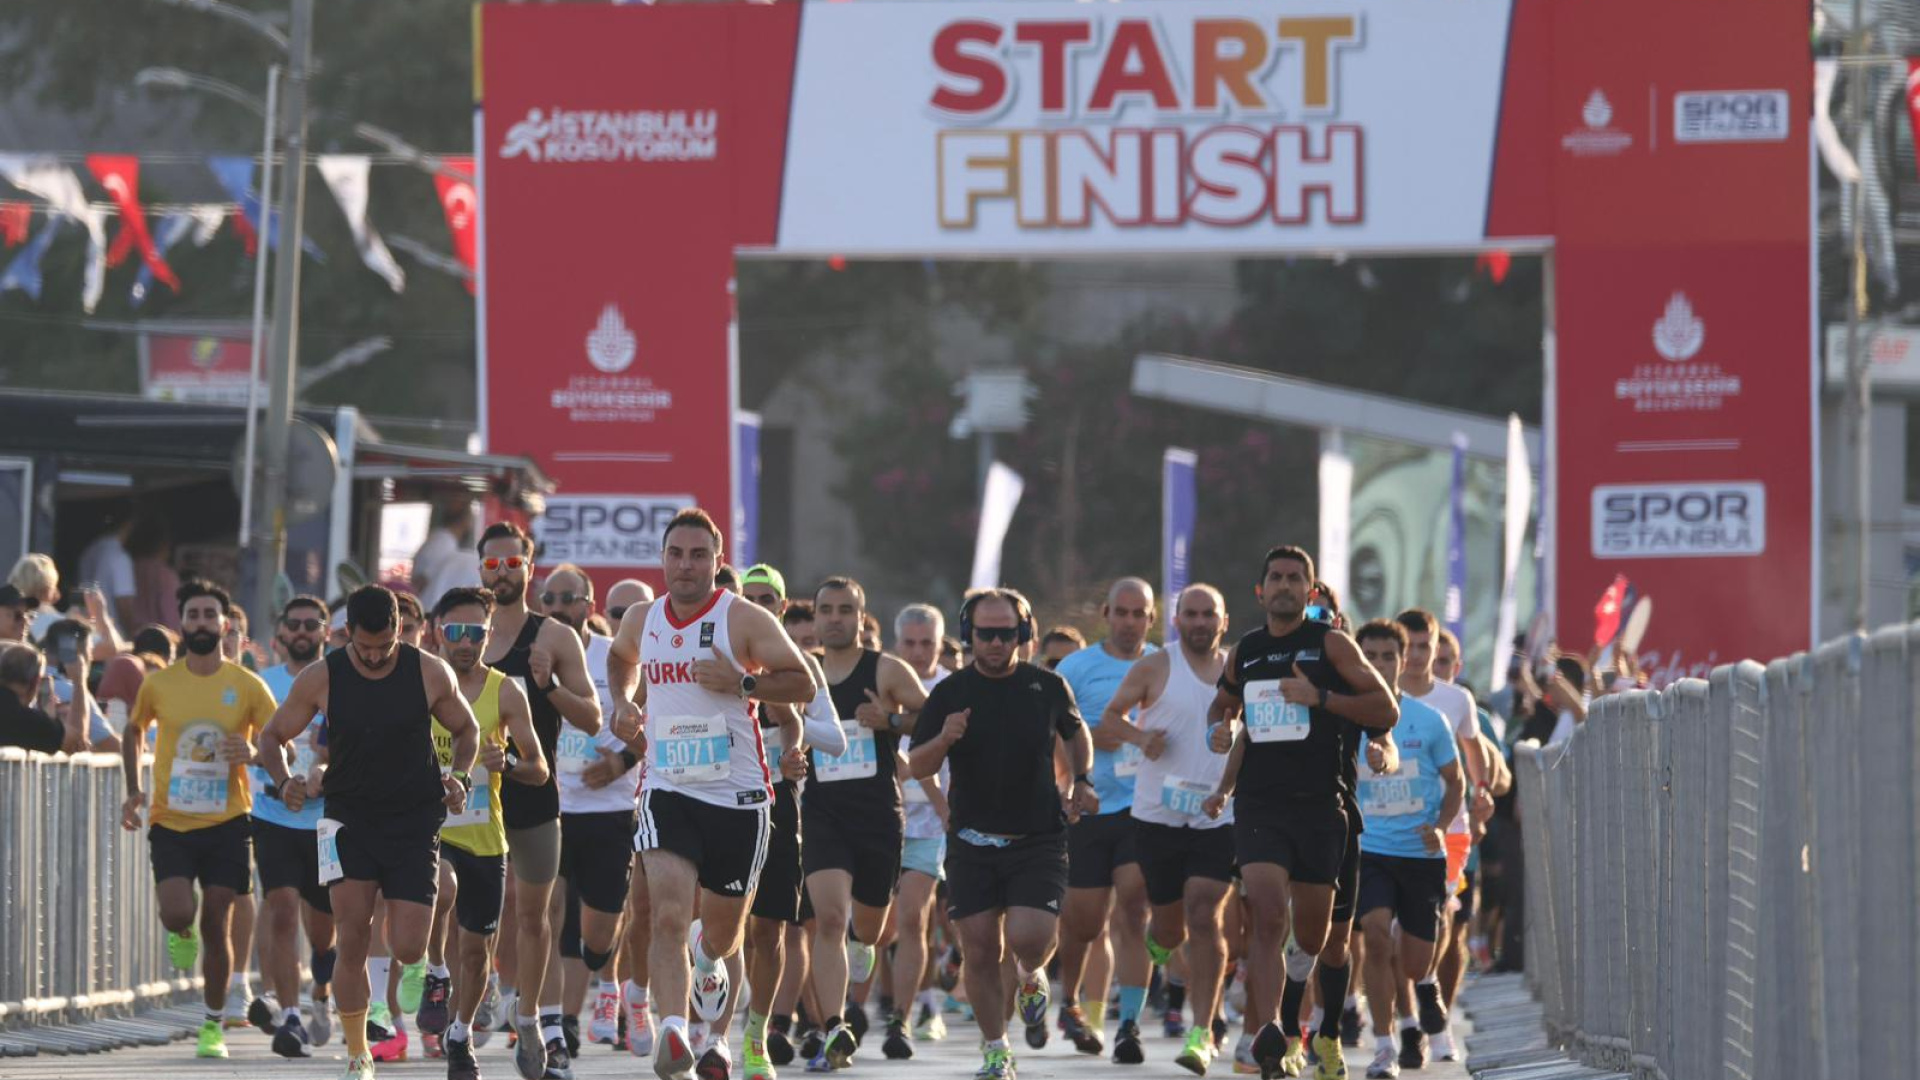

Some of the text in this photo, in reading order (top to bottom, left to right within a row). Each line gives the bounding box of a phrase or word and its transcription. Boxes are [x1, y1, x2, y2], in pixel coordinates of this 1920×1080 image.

[929, 15, 1356, 115] START
[935, 124, 1364, 229] FINISH
[1605, 490, 1749, 524] SPOR
[665, 739, 716, 767] 5071
